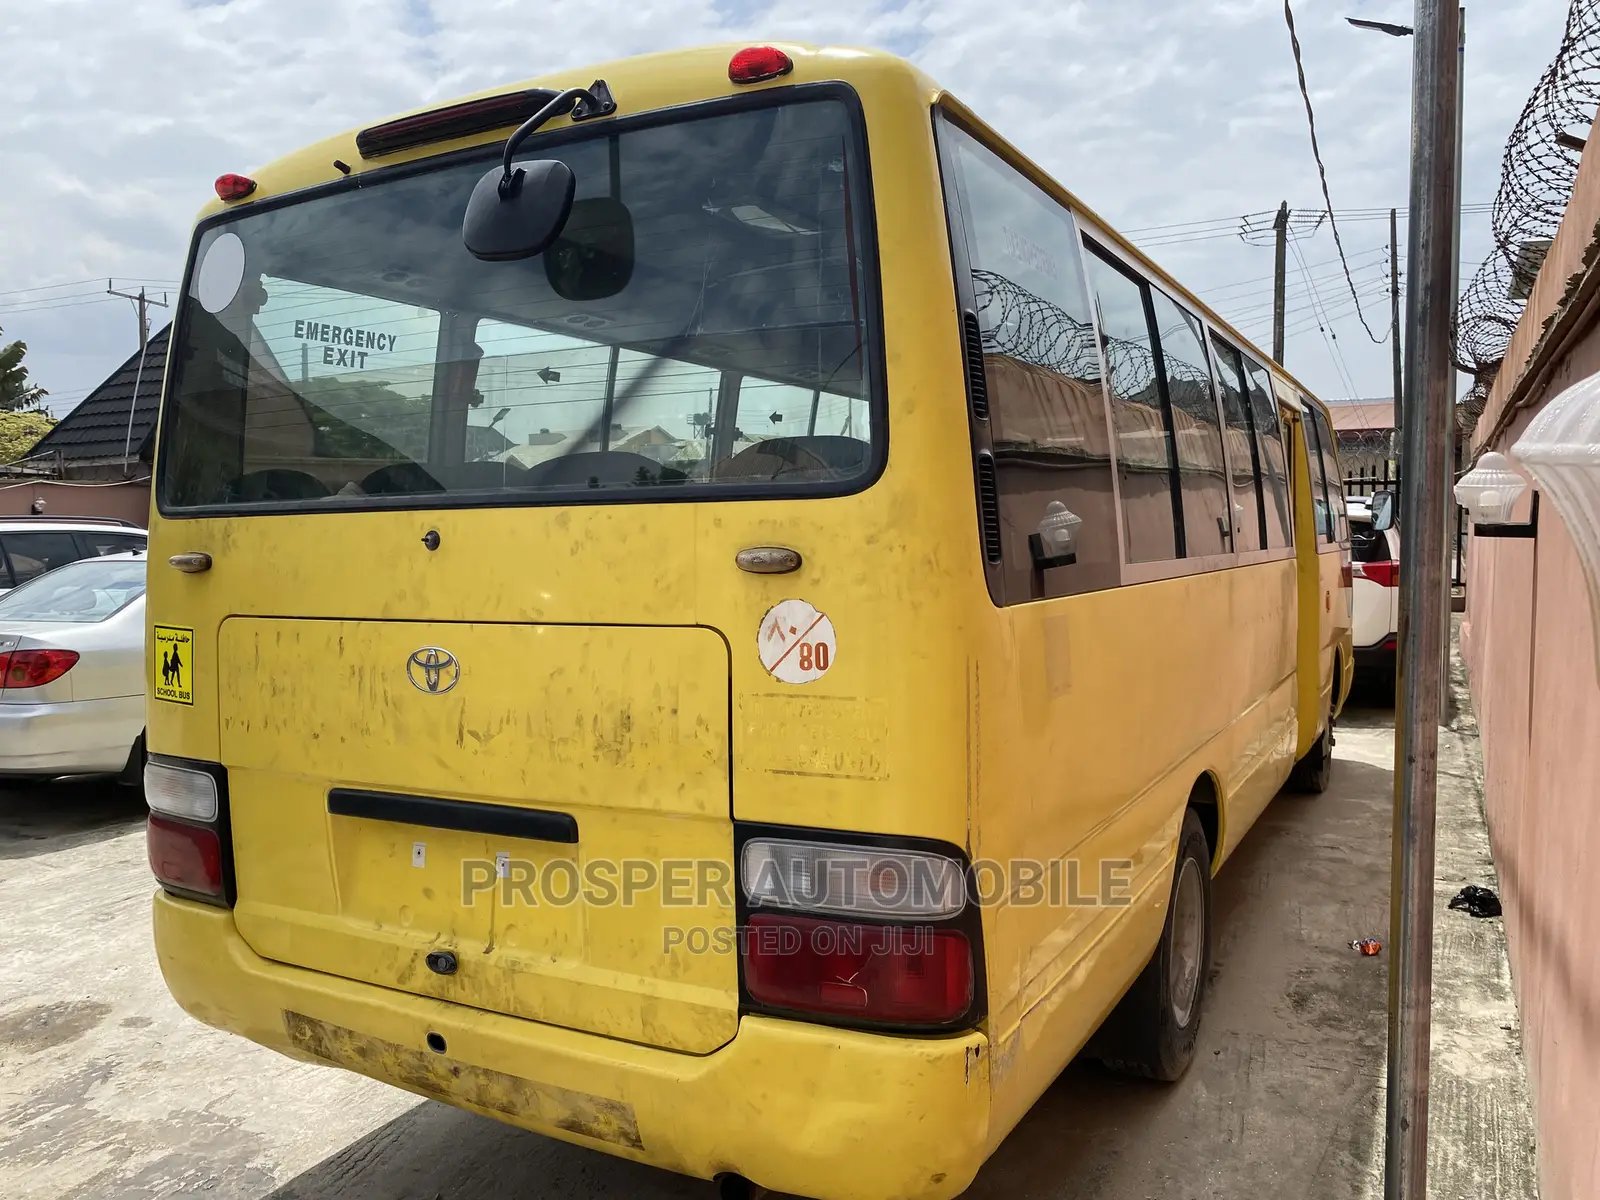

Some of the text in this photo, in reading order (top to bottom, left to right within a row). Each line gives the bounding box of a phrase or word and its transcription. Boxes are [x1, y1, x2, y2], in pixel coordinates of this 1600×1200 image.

[294, 319, 397, 352] EMERGENCY
[322, 346, 369, 369] EXIT
[799, 642, 829, 671] 80
[156, 687, 191, 700] SCHOOL BUS
